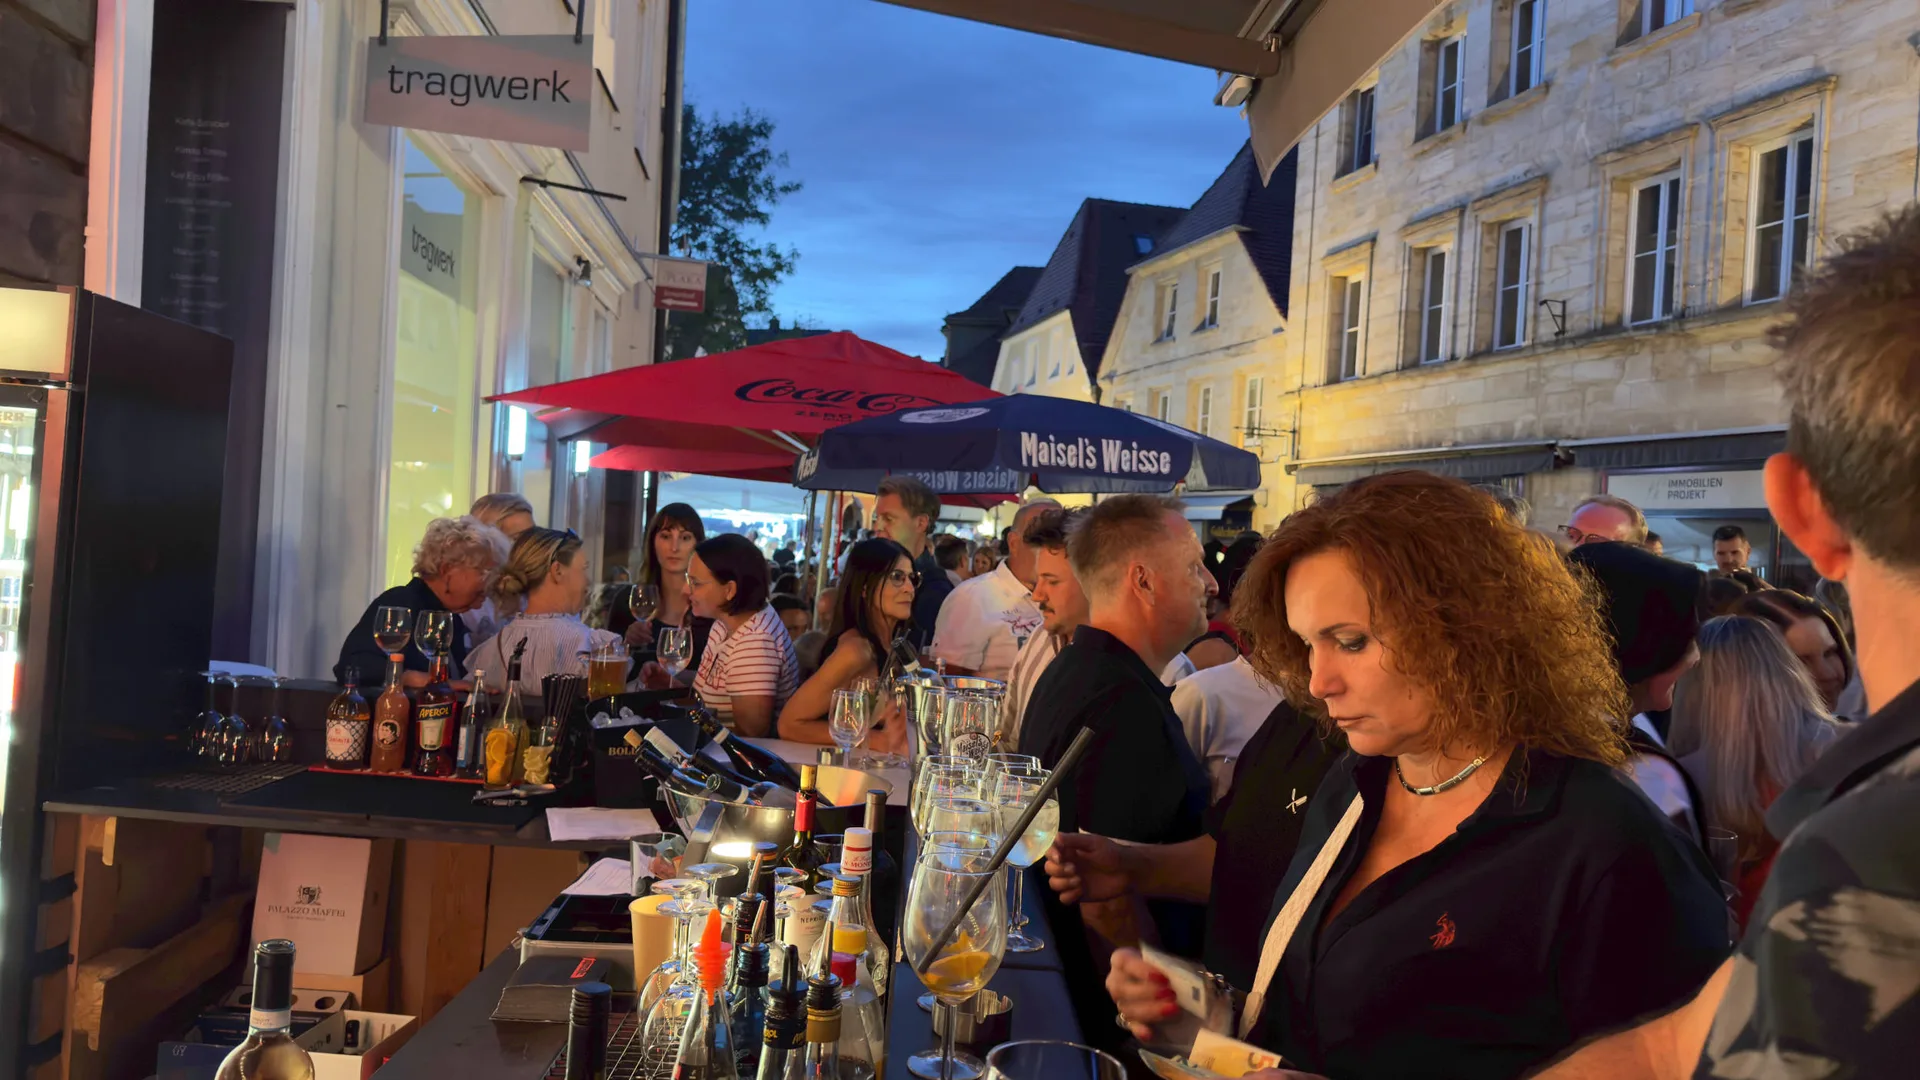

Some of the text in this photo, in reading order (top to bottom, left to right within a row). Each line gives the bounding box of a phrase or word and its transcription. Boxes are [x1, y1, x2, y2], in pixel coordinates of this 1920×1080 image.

[388, 65, 571, 107] tragwerk
[412, 224, 456, 279] tragwerk
[1020, 431, 1172, 475] Maisel's Weisse
[1668, 477, 1723, 488] IMMOBILIEN
[1667, 489, 1707, 500] PROJEKT
[419, 706, 449, 719] APEROL
[268, 904, 310, 915] PALAZZO
